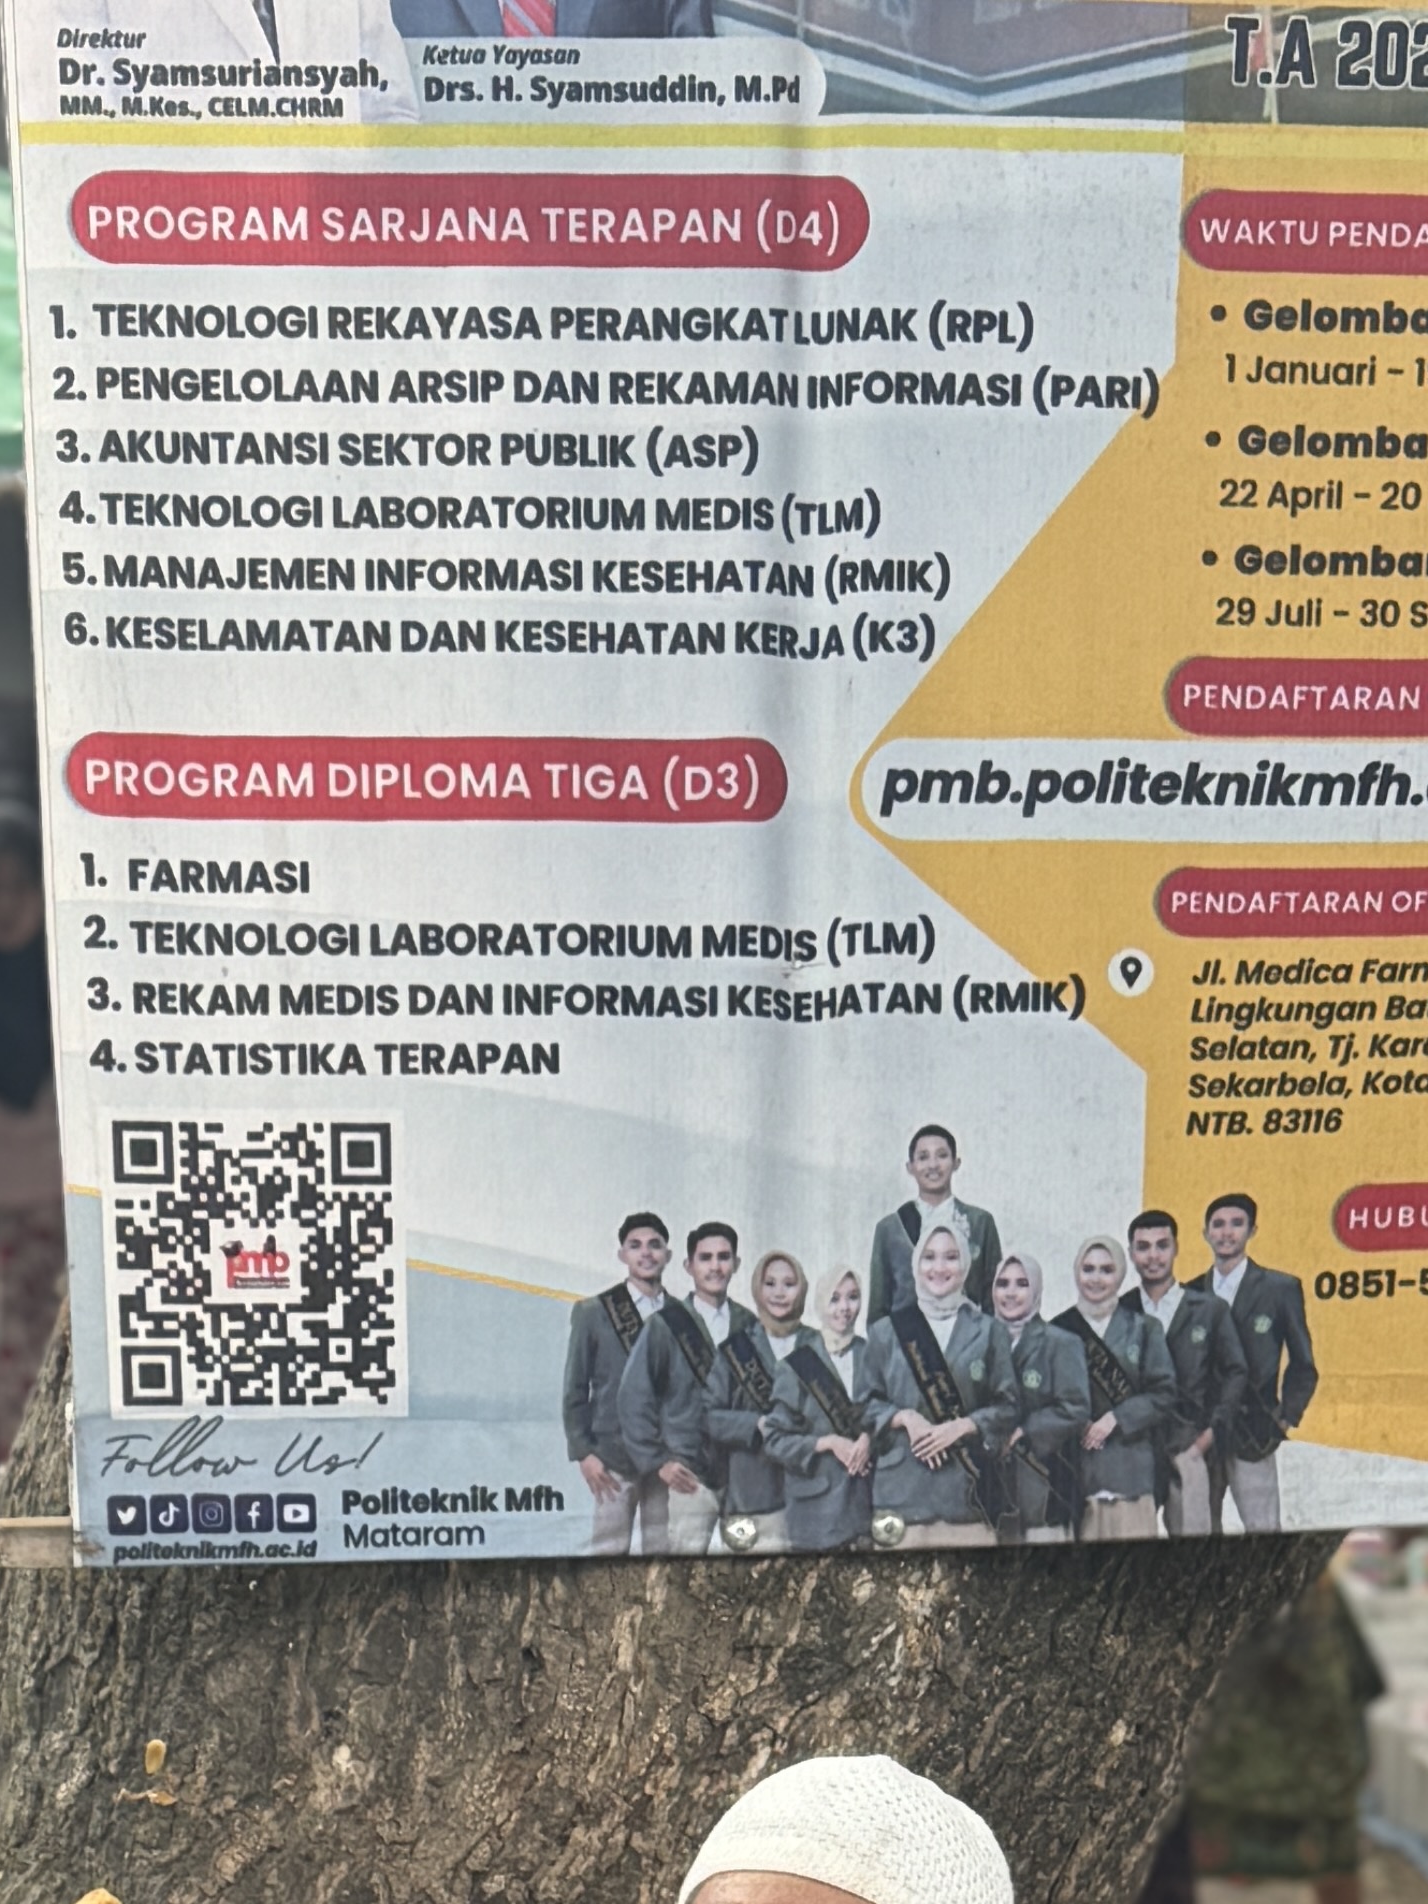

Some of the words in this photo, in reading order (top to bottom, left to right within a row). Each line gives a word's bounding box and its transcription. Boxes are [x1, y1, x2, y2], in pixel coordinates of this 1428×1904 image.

[57, 28, 146, 48] Direktur
[1226, 16, 1317, 86] T.A
[422, 45, 486, 65] Ketua
[493, 45, 580, 69] Yayasan
[58, 57, 105, 86] Dr.
[113, 57, 388, 94] Syamsuriansyah,
[424, 76, 483, 102] Drs.
[492, 76, 522, 102] H.
[530, 74, 725, 109] Syamsuddin,
[734, 75, 800, 104] M.Pd
[208, 97, 343, 118] CELM.CHRM
[89, 205, 308, 241] PROGRAM
[322, 207, 529, 242] SARJANA
[541, 208, 741, 243] TERAPAN
[757, 199, 838, 256] (D4)
[1201, 218, 1319, 246] WAKTU
[49, 305, 77, 339] 1.
[92, 304, 318, 339] TEKNOLOGI
[328, 307, 542, 340] REKAYASA
[551, 306, 789, 342] PERANGKAT
[794, 308, 918, 345] LUNAK
[929, 300, 1034, 352] (RPL)
[1226, 354, 1235, 382] 1
[1246, 354, 1376, 386] Januari
[52, 367, 87, 400] 2.
[96, 368, 380, 403] PENGELOLAAN
[389, 370, 505, 404] ARSIP
[514, 371, 600, 405] DAN
[610, 372, 799, 408] REKAMAN
[807, 372, 1022, 409] INFORMASI
[1033, 365, 1159, 420] (PARI)
[56, 429, 91, 463] 3.
[98, 430, 330, 465] AKUNTANSI
[339, 432, 491, 466] SEKTOR
[500, 434, 635, 467] PUBLIK
[646, 426, 759, 476] (ASP)
[59, 492, 96, 525] 4.
[100, 493, 322, 528] TEKNOLOGI
[332, 496, 645, 530] LABORATORIUM
[655, 498, 774, 531] MEDIS
[782, 488, 880, 543] (TLM)
[1220, 479, 1257, 508] 22
[1267, 481, 1342, 517] April
[1380, 483, 1421, 510] 20
[62, 553, 97, 586] 5.
[104, 555, 355, 590] MANAJEMEN
[365, 559, 583, 592] INFORMASI
[593, 560, 814, 597] KESEHATAN
[825, 552, 950, 604] (RMIK)
[1216, 598, 1255, 626] 29
[1265, 598, 1322, 627] Juli
[1359, 600, 1400, 627] 30
[64, 614, 99, 647] 6.
[105, 616, 391, 652] KESELAMATAN
[401, 619, 487, 653] DAN
[495, 621, 724, 655] KESEHATAN
[735, 622, 844, 661] KERJA
[853, 612, 936, 662] (K3)
[1184, 685, 1420, 710] PENDAFTARAN
[85, 759, 314, 798] PROGRAM
[328, 762, 531, 799] DIPLOMA
[544, 764, 648, 801] TIGA
[664, 753, 760, 812] (D3)
[79, 853, 107, 888] 1.
[129, 859, 309, 893] FARMASI
[1172, 891, 1383, 914] PENDAFTARAN
[84, 915, 119, 949] 2.
[130, 920, 360, 956] TEKNOLOGI
[370, 923, 692, 958] LABORATORIUM
[702, 925, 817, 962] MEDIS
[827, 914, 935, 967] (TLM)
[1192, 960, 1226, 985] Jl.
[1235, 959, 1353, 985] Medica
[87, 977, 121, 1011] 3.
[133, 982, 269, 1015] REKAM
[279, 984, 399, 1015] MEDIS
[409, 985, 493, 1015] DAN
[503, 984, 717, 1017] INFORMASI
[728, 984, 941, 1022] KESEHATAN
[954, 974, 1086, 1022] (RMIK)
[1191, 998, 1377, 1030] Lingkungan
[90, 1040, 127, 1074] 4.
[135, 1042, 367, 1075] STATISTIKA
[374, 1043, 560, 1075] TERAPAN
[1189, 1035, 1317, 1064] Selatan,
[1328, 1035, 1359, 1067] Tj.
[1188, 1072, 1352, 1099] Sekarbela,
[1186, 1110, 1252, 1136] NTB.
[1262, 1108, 1343, 1135] 83116
[101, 1415, 256, 1478] Follow
[275, 1432, 383, 1477] Us!
[342, 1485, 498, 1516] Politeknik
[506, 1485, 564, 1512] Mfh
[113, 1540, 317, 1563] politeknikmfh.ac.id
[343, 1523, 484, 1548] Mataram
